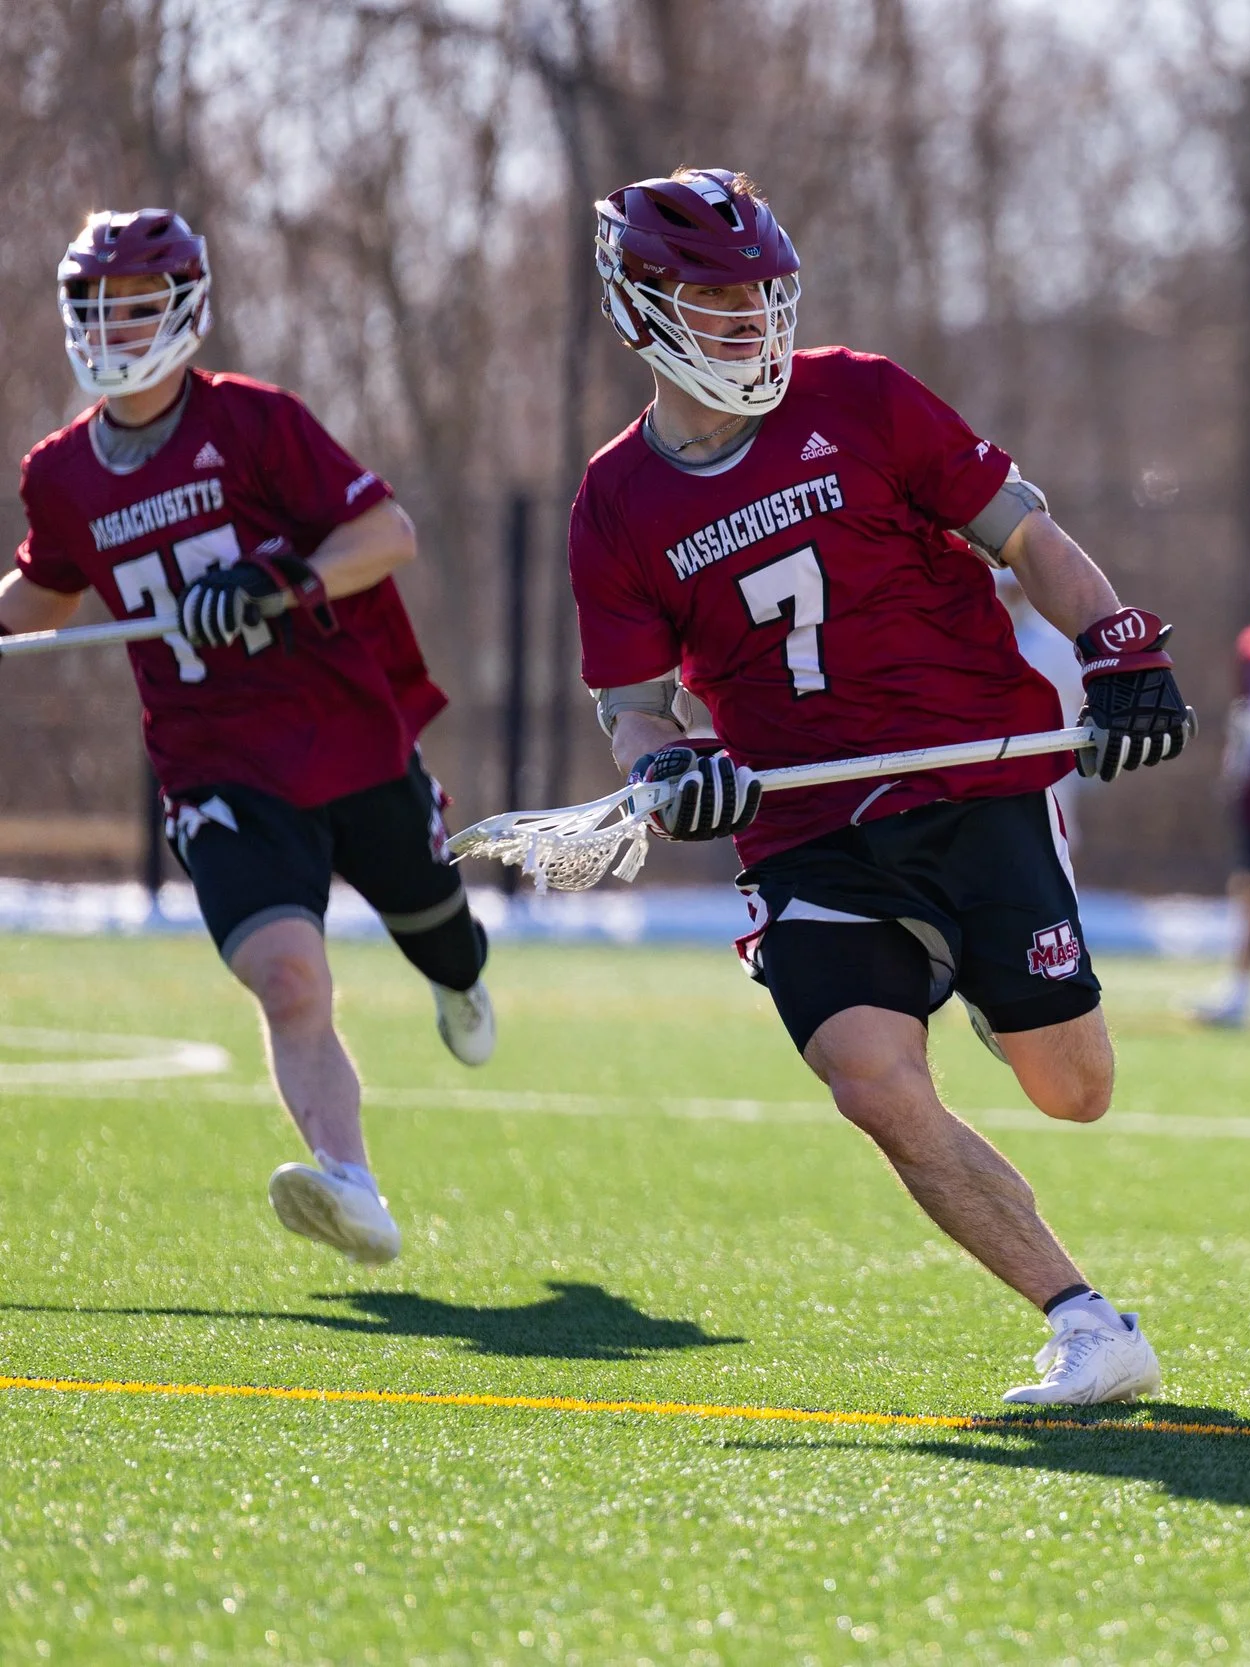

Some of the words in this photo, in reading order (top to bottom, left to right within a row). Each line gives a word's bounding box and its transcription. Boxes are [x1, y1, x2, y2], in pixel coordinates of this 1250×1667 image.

[800, 444, 839, 462] adidas
[88, 476, 225, 552] MASSACHUSETTS
[664, 472, 845, 583] MASSACHUSETTS
[735, 542, 828, 699] 7
[1029, 939, 1080, 973] MASS
